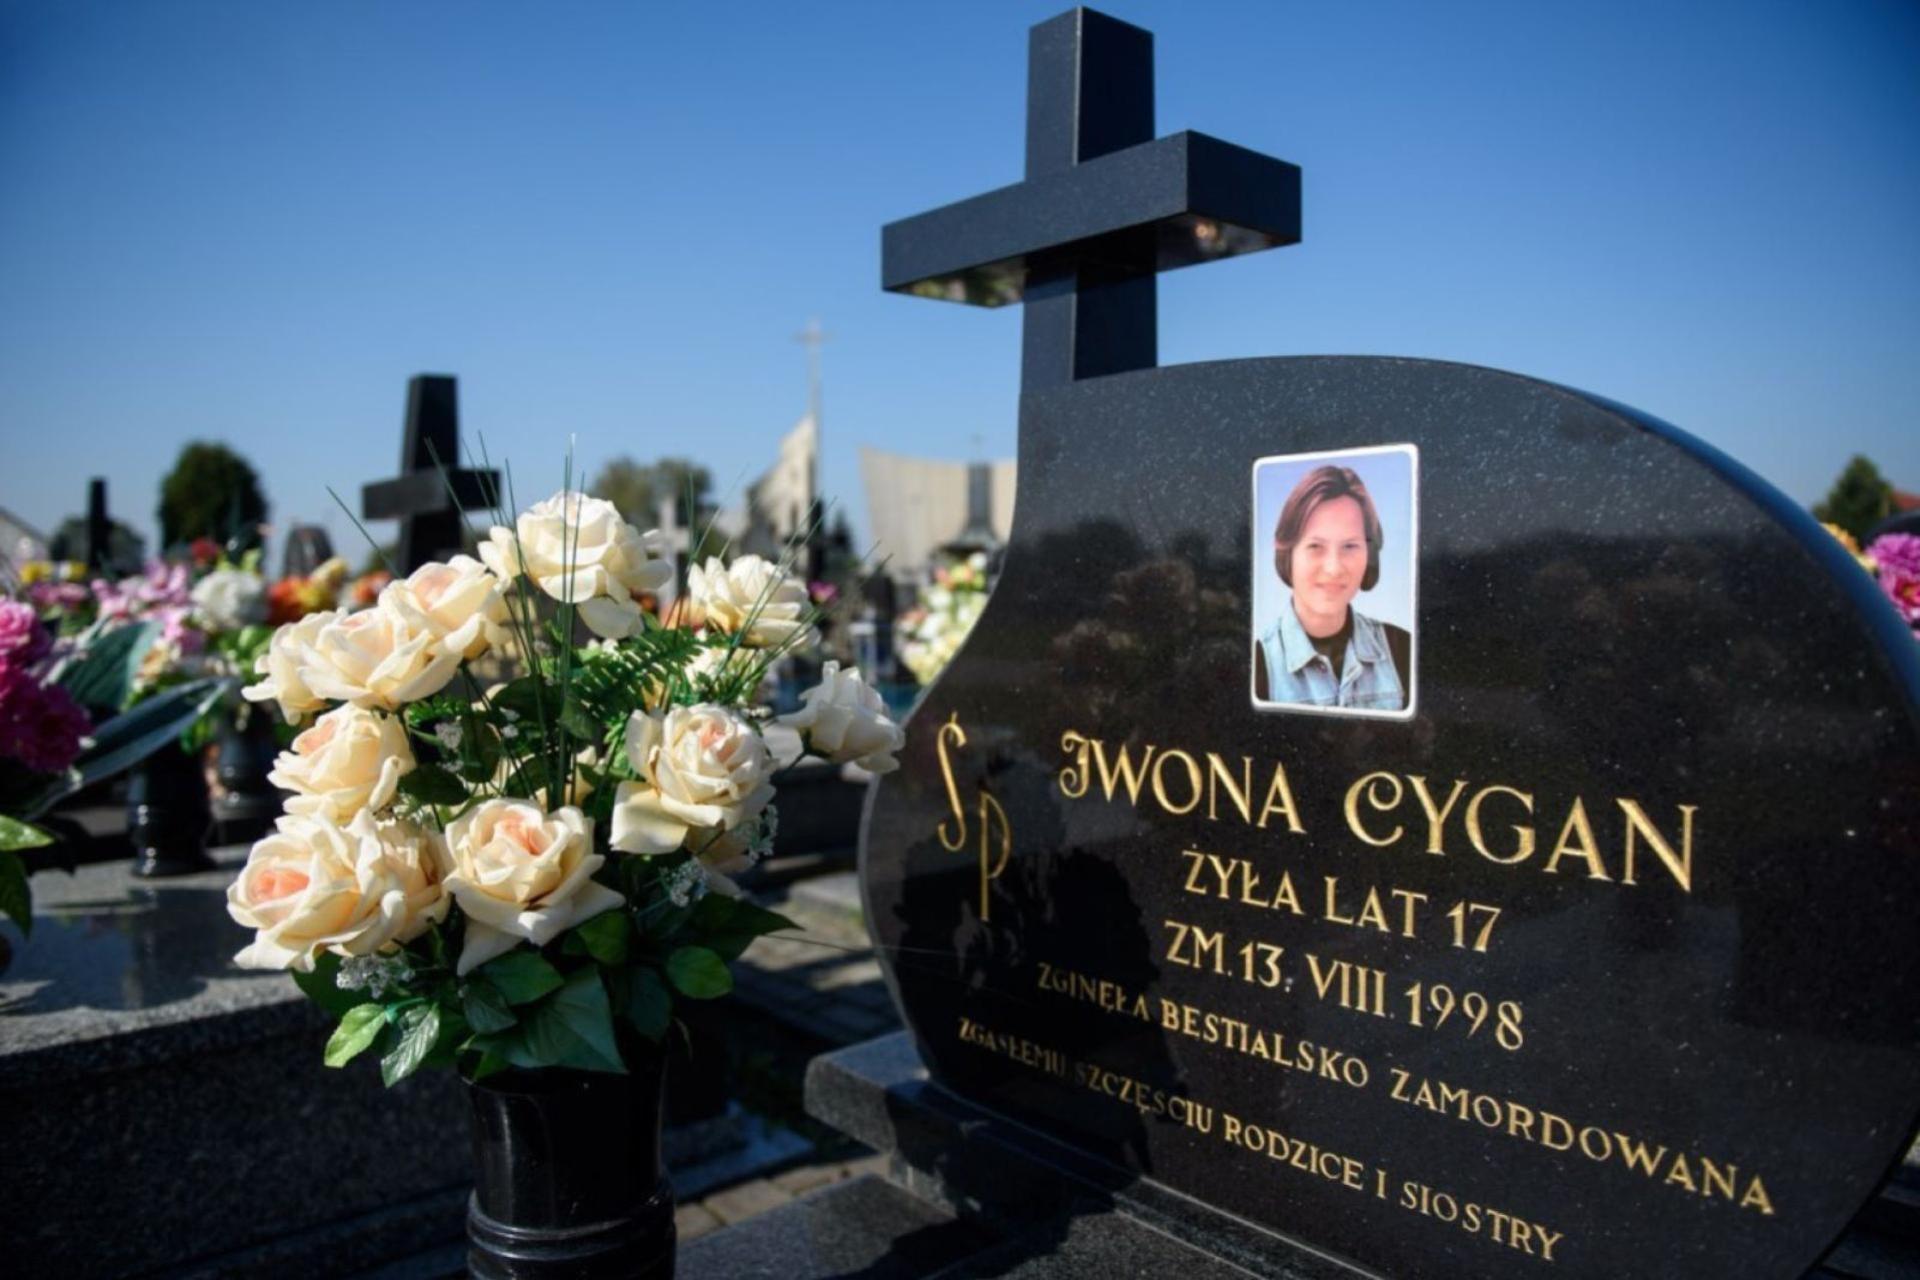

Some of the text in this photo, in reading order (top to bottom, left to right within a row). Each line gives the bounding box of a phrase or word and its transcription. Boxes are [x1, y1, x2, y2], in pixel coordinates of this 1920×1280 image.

[1343, 771, 1699, 893] CYGAN
[1182, 844, 1501, 953] ŻYŁA LAT 17
[1404, 982, 1524, 1051] 1998
[1161, 998, 1369, 1088] BESTIALSKO
[1390, 1067, 1775, 1215] ZAMORDOWANA
[1223, 1114, 1364, 1191] RODZICE
[1376, 1169, 1388, 1199] I
[1400, 1181, 1564, 1262] SIOSTRY
